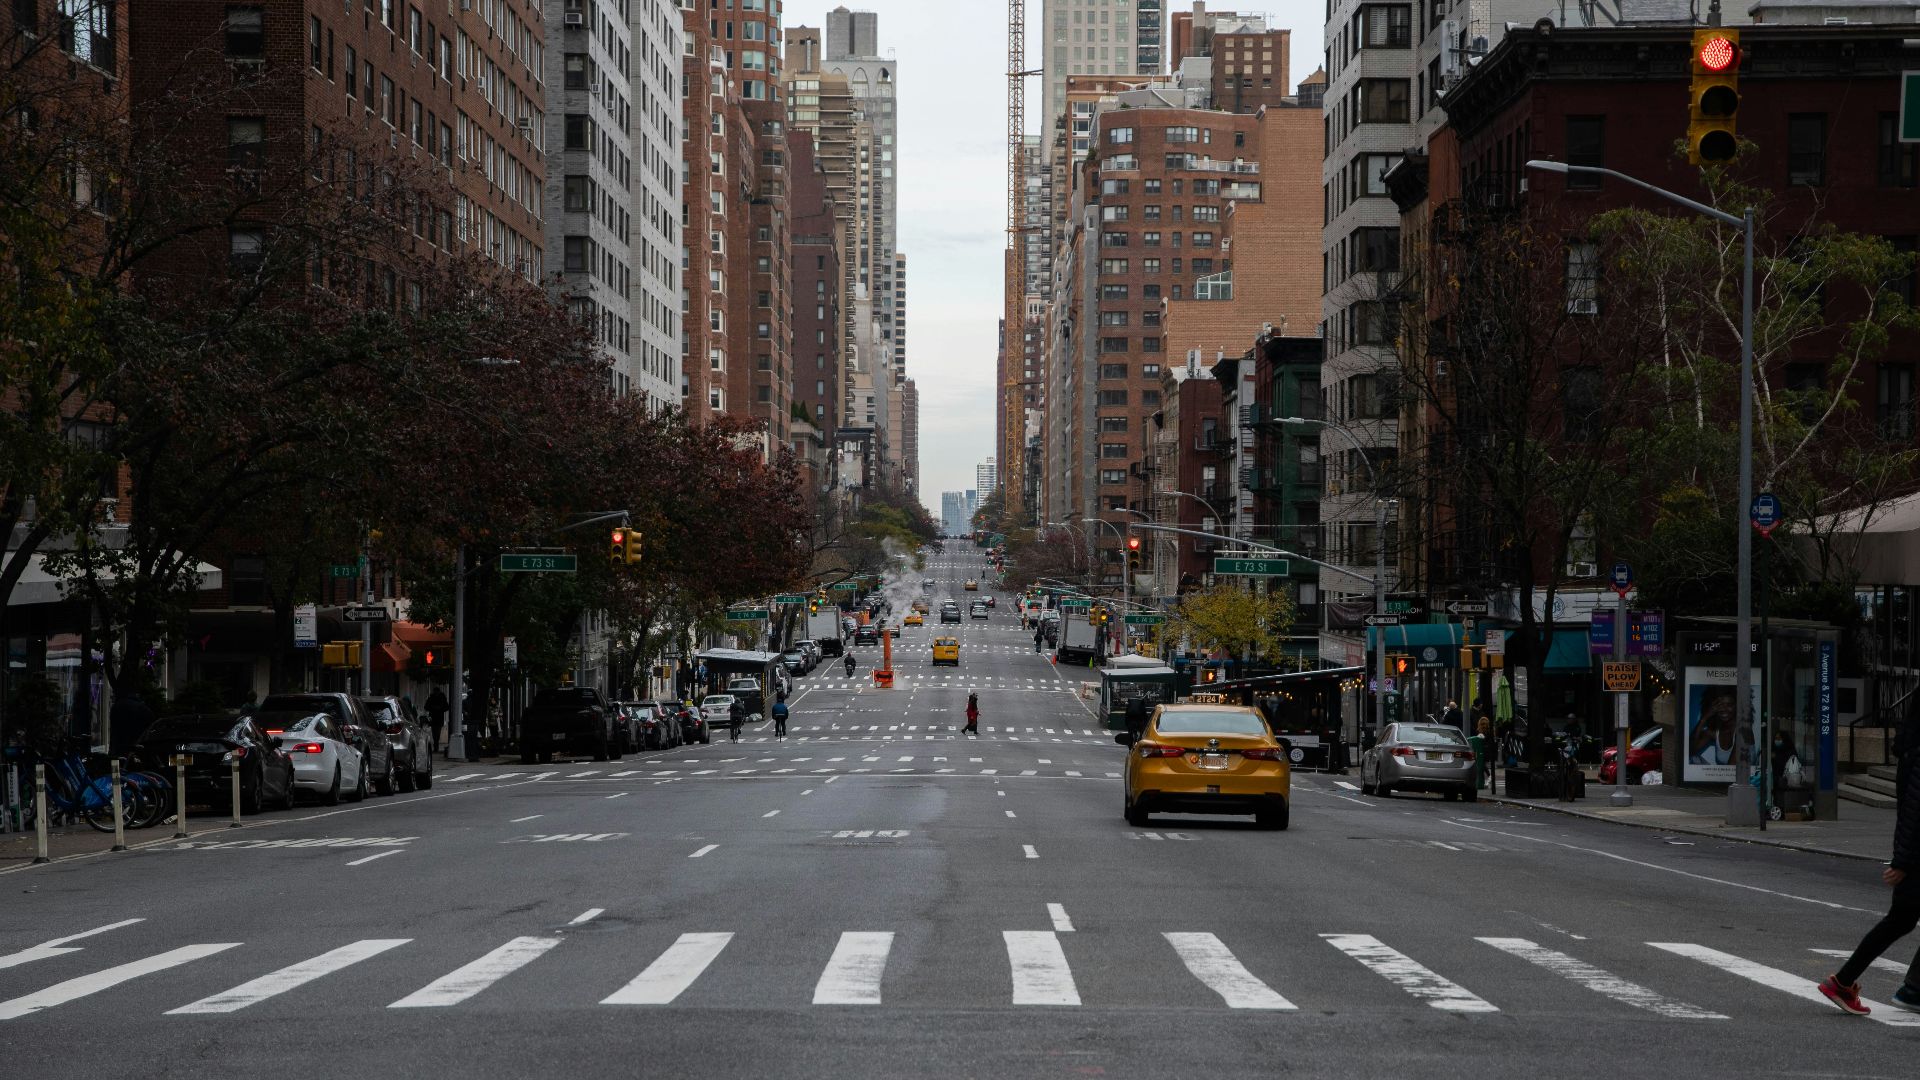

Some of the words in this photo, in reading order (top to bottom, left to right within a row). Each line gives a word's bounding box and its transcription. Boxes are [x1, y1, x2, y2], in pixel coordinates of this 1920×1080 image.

[522, 558, 528, 568] E
[532, 558, 542, 568] 73
[545, 558, 555, 568] St
[1235, 562, 1241, 571] E
[1244, 562, 1255, 572] 73
[1258, 562, 1268, 572] St
[342, 567, 350, 576] 73
[1694, 642, 1715, 651] 11:52
[1607, 664, 1638, 672] RAISE
[1821, 653, 1830, 684] Avenue
[1607, 673, 1637, 681] PLOW
[1821, 693, 1830, 704] 72
[1821, 713, 1830, 724] 73
[1821, 725, 1830, 735] St
